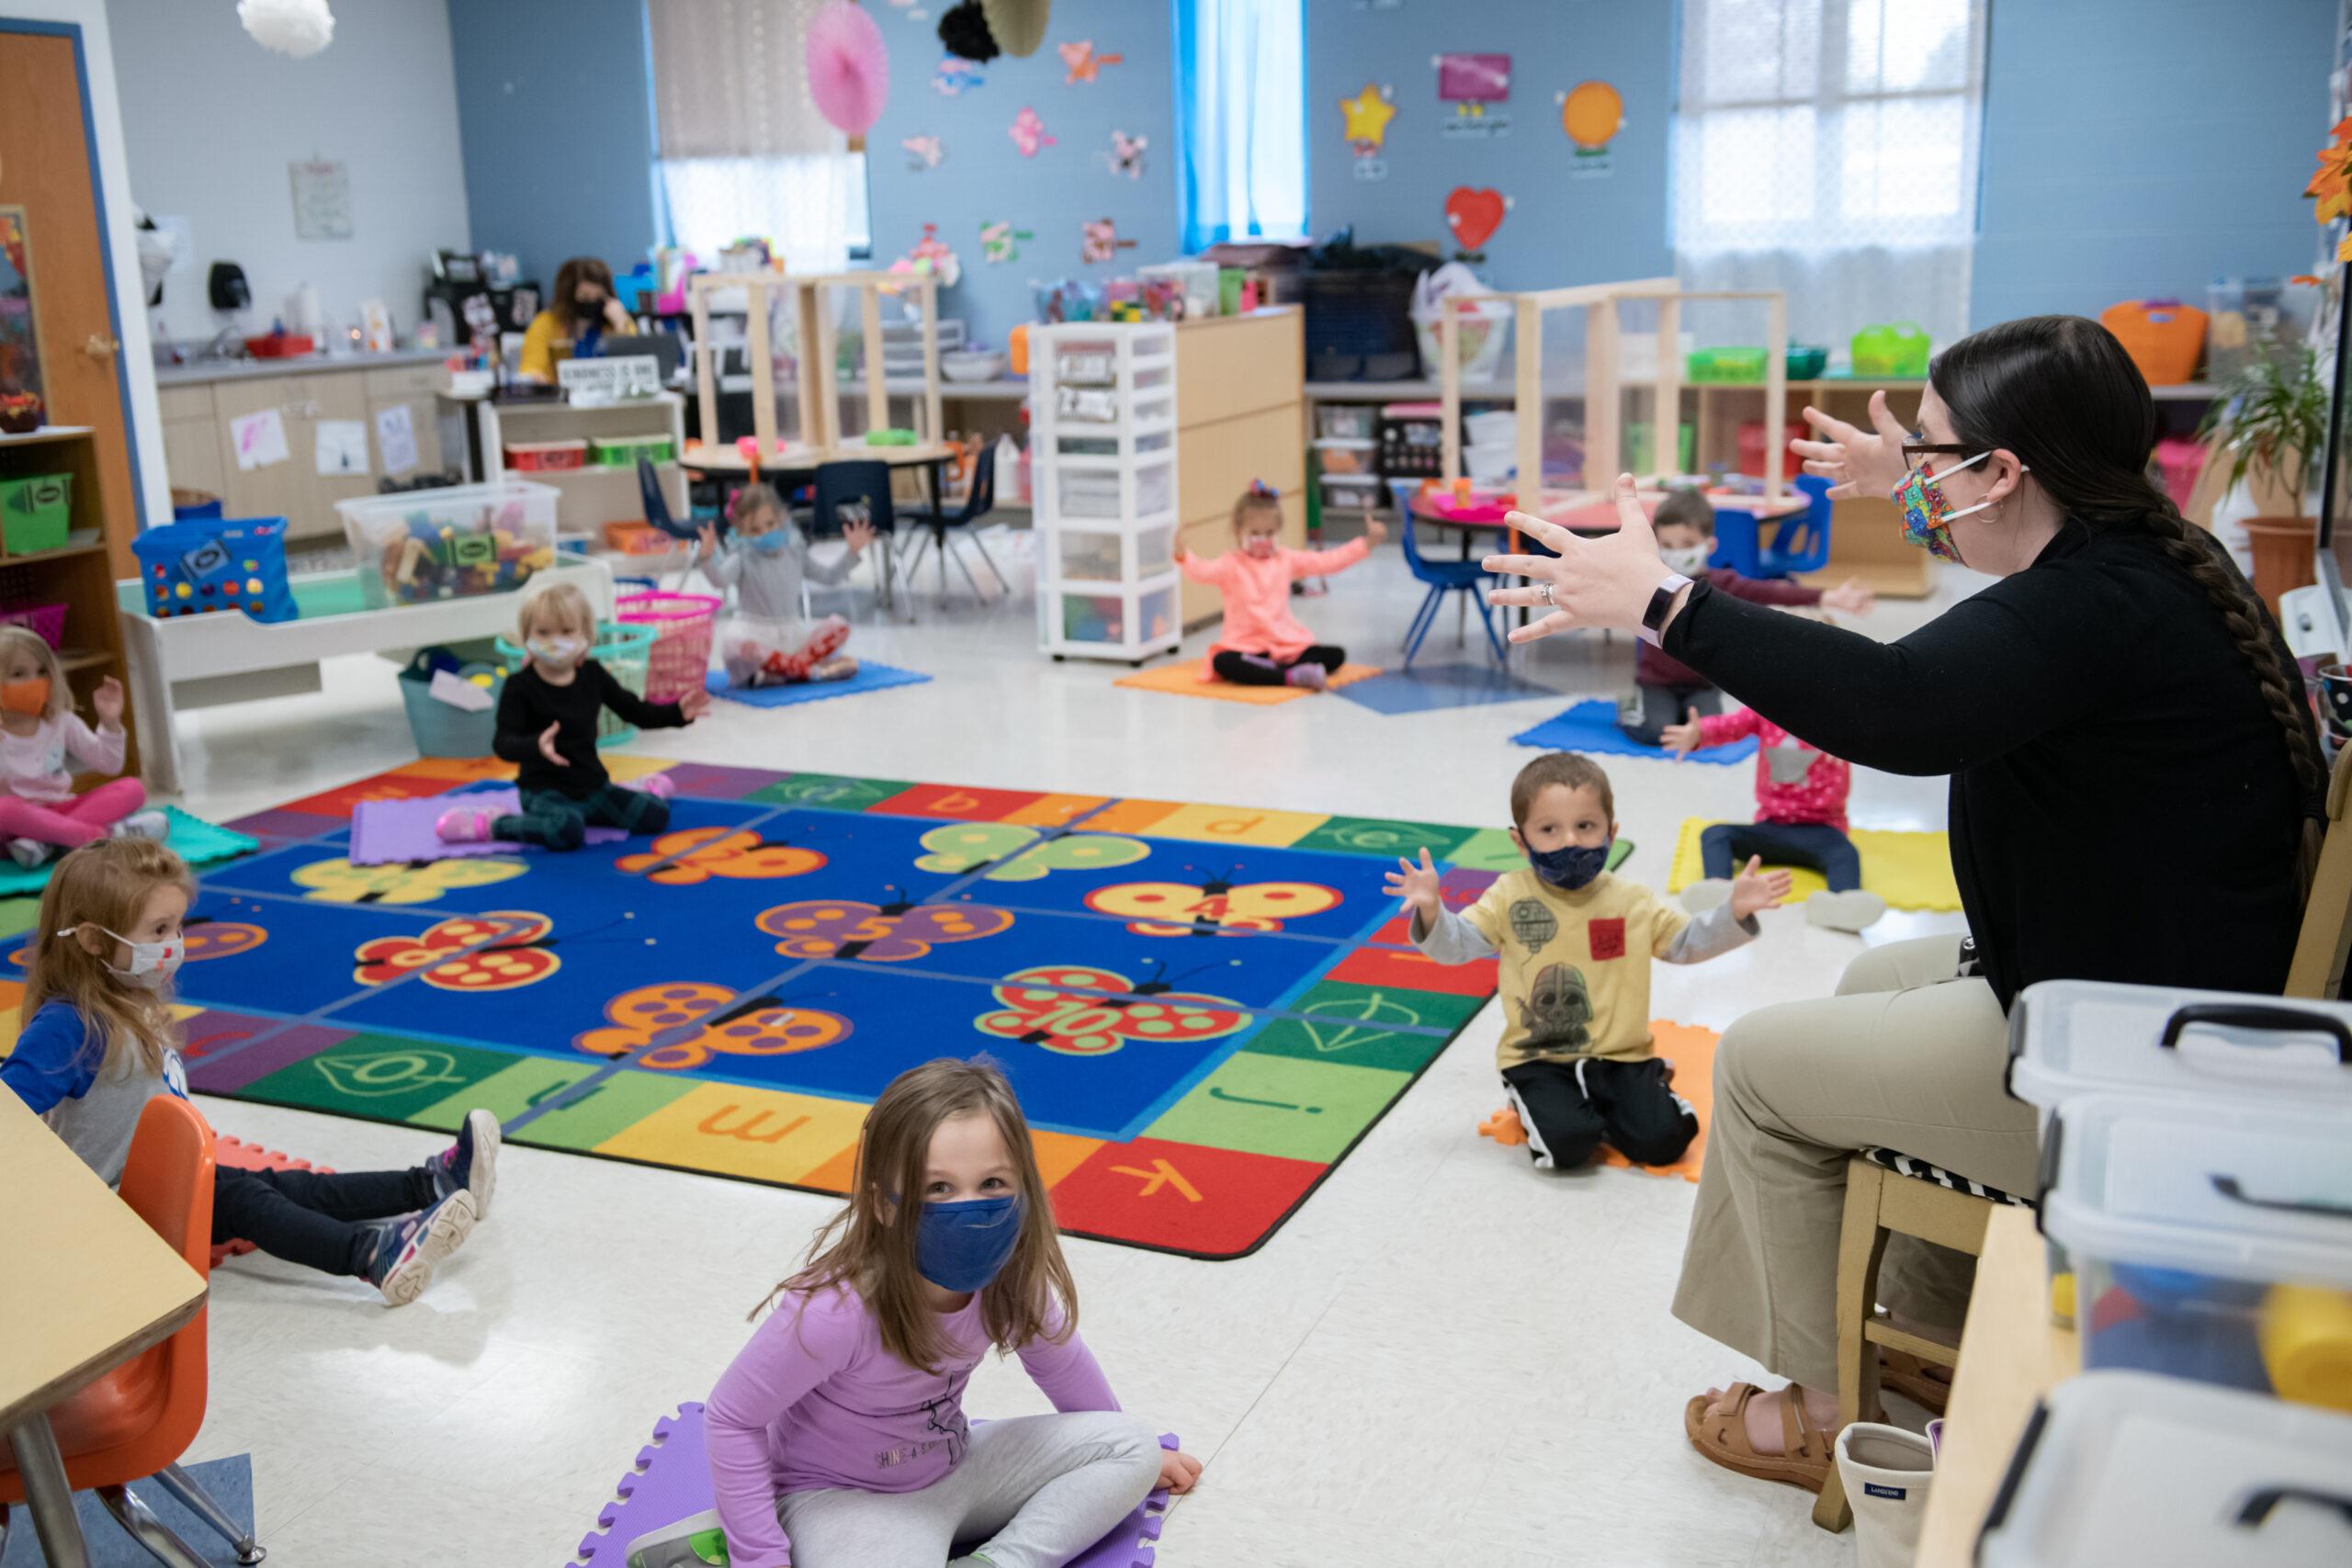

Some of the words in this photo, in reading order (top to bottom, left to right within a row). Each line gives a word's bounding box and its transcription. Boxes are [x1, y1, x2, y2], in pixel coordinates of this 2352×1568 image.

[1182, 896, 1236, 919] 4
[840, 917, 903, 942] 5
[1023, 1000, 1124, 1036] 10
